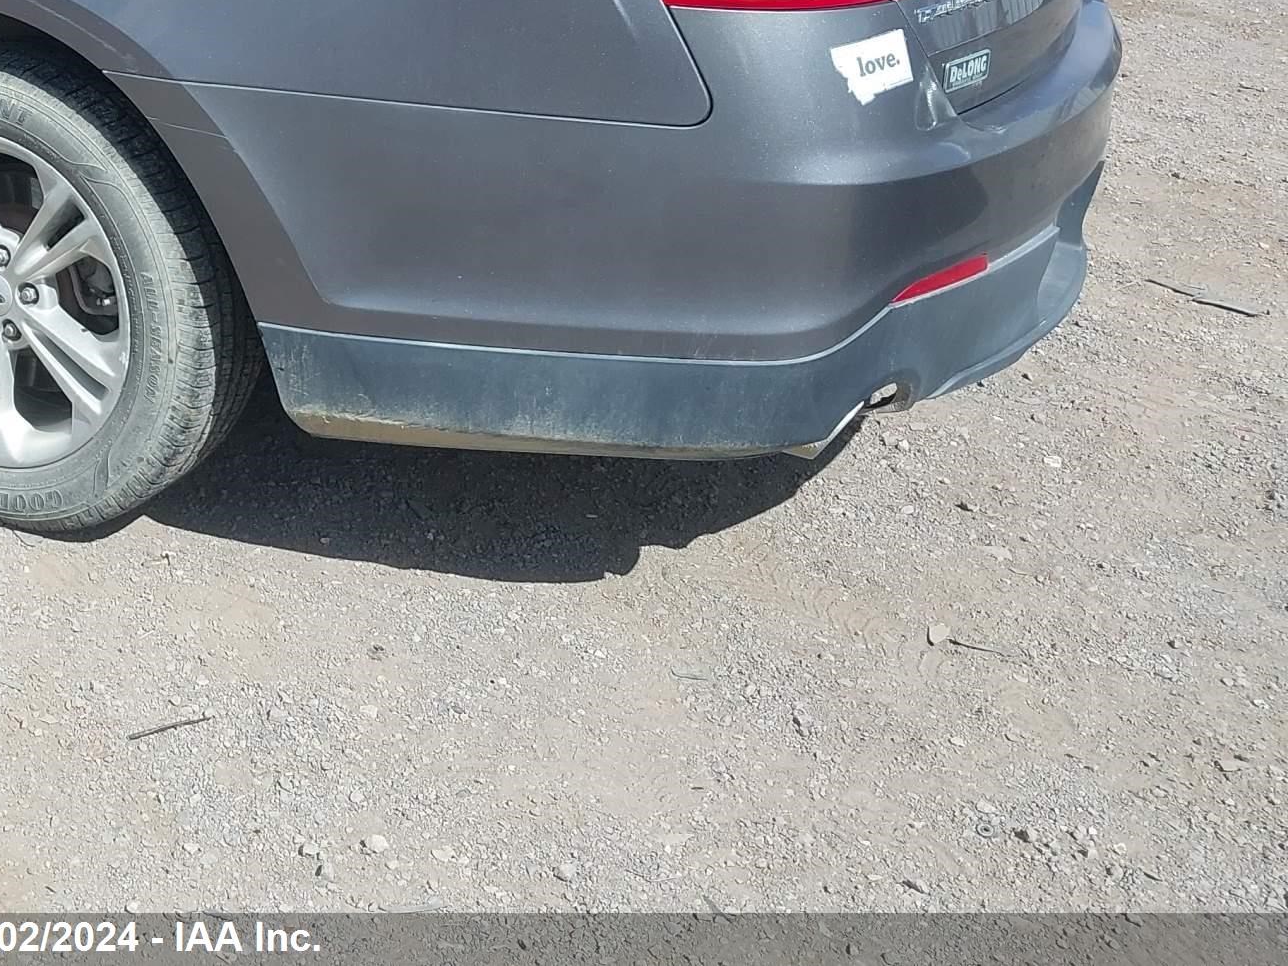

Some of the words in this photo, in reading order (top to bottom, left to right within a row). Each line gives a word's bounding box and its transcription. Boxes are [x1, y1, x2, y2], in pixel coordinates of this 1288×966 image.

[857, 53, 900, 77] love.
[949, 54, 988, 83] DeLONG
[140, 270, 162, 404] ALL-SEASON
